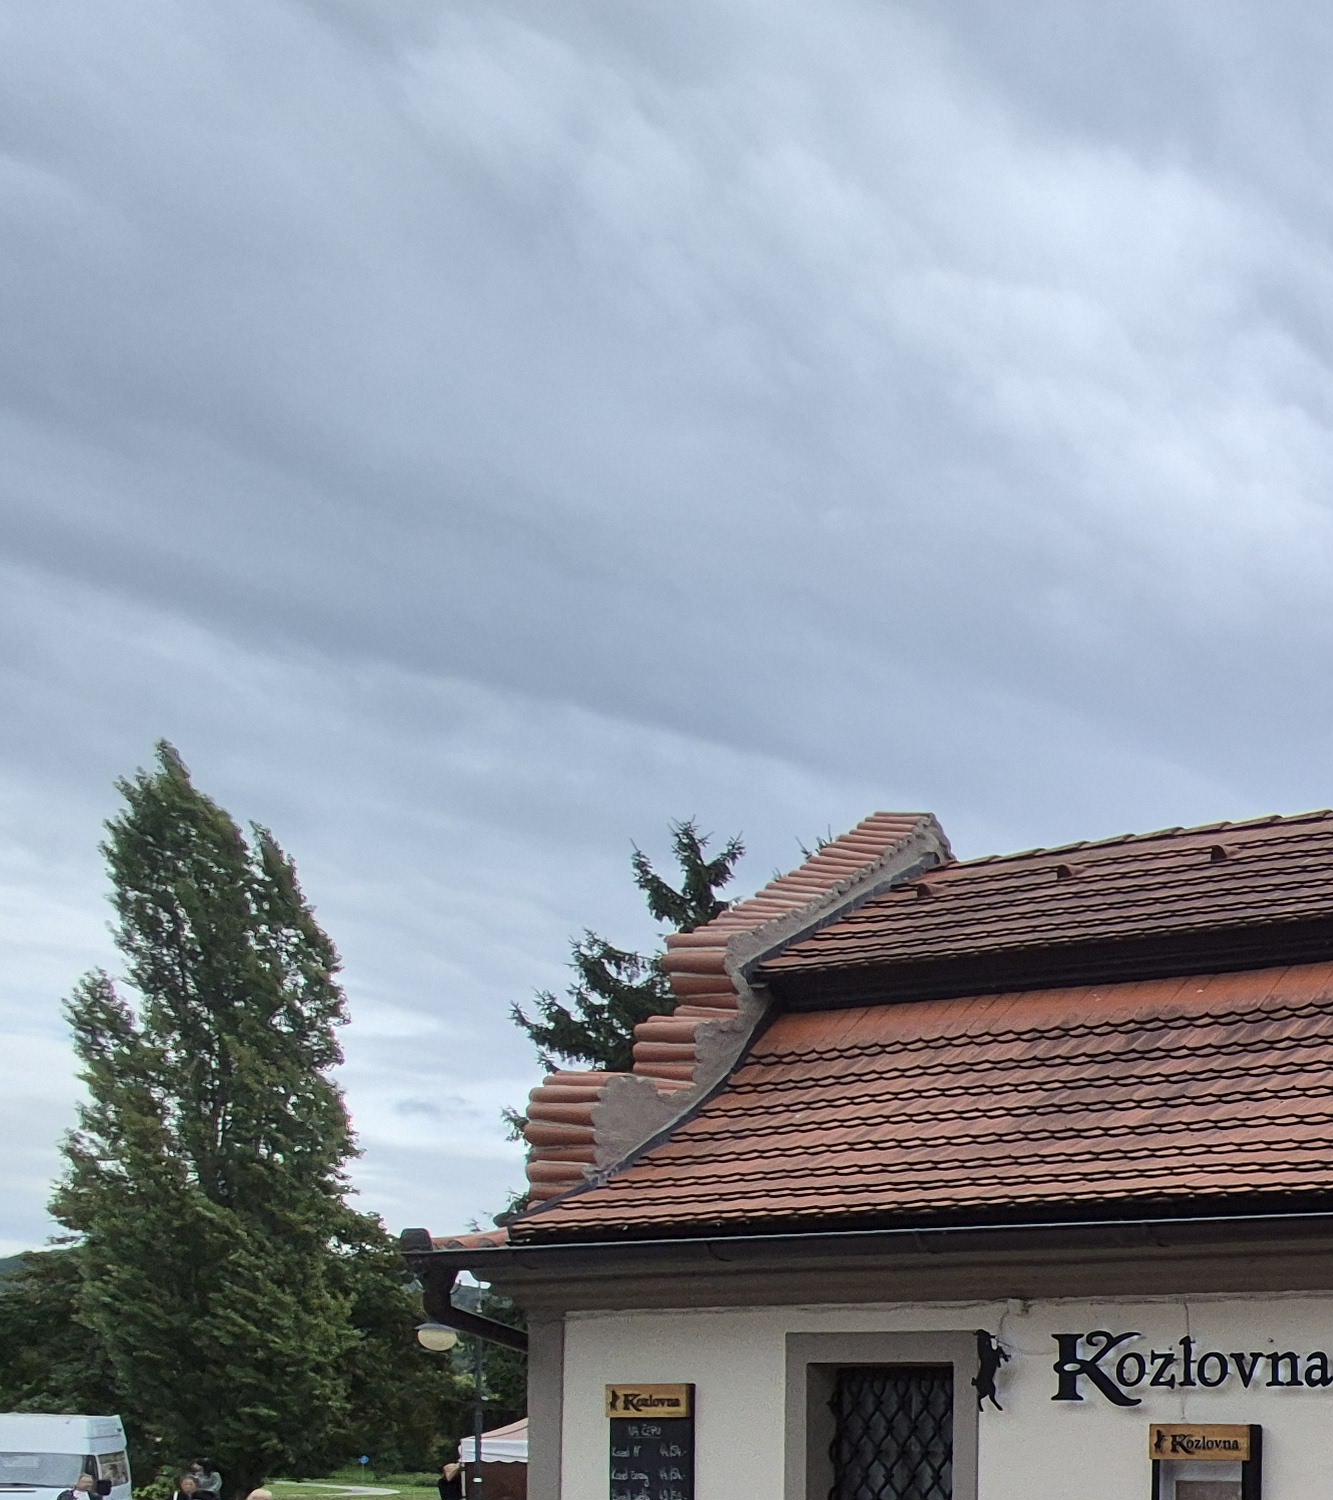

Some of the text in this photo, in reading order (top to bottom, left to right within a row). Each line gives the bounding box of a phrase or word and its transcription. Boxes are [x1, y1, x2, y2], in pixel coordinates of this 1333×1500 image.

[1050, 1330, 1333, 1407] Kozlovna
[623, 1393, 681, 1412] Kozlovna
[1170, 1433, 1241, 1455] Kozlovna
